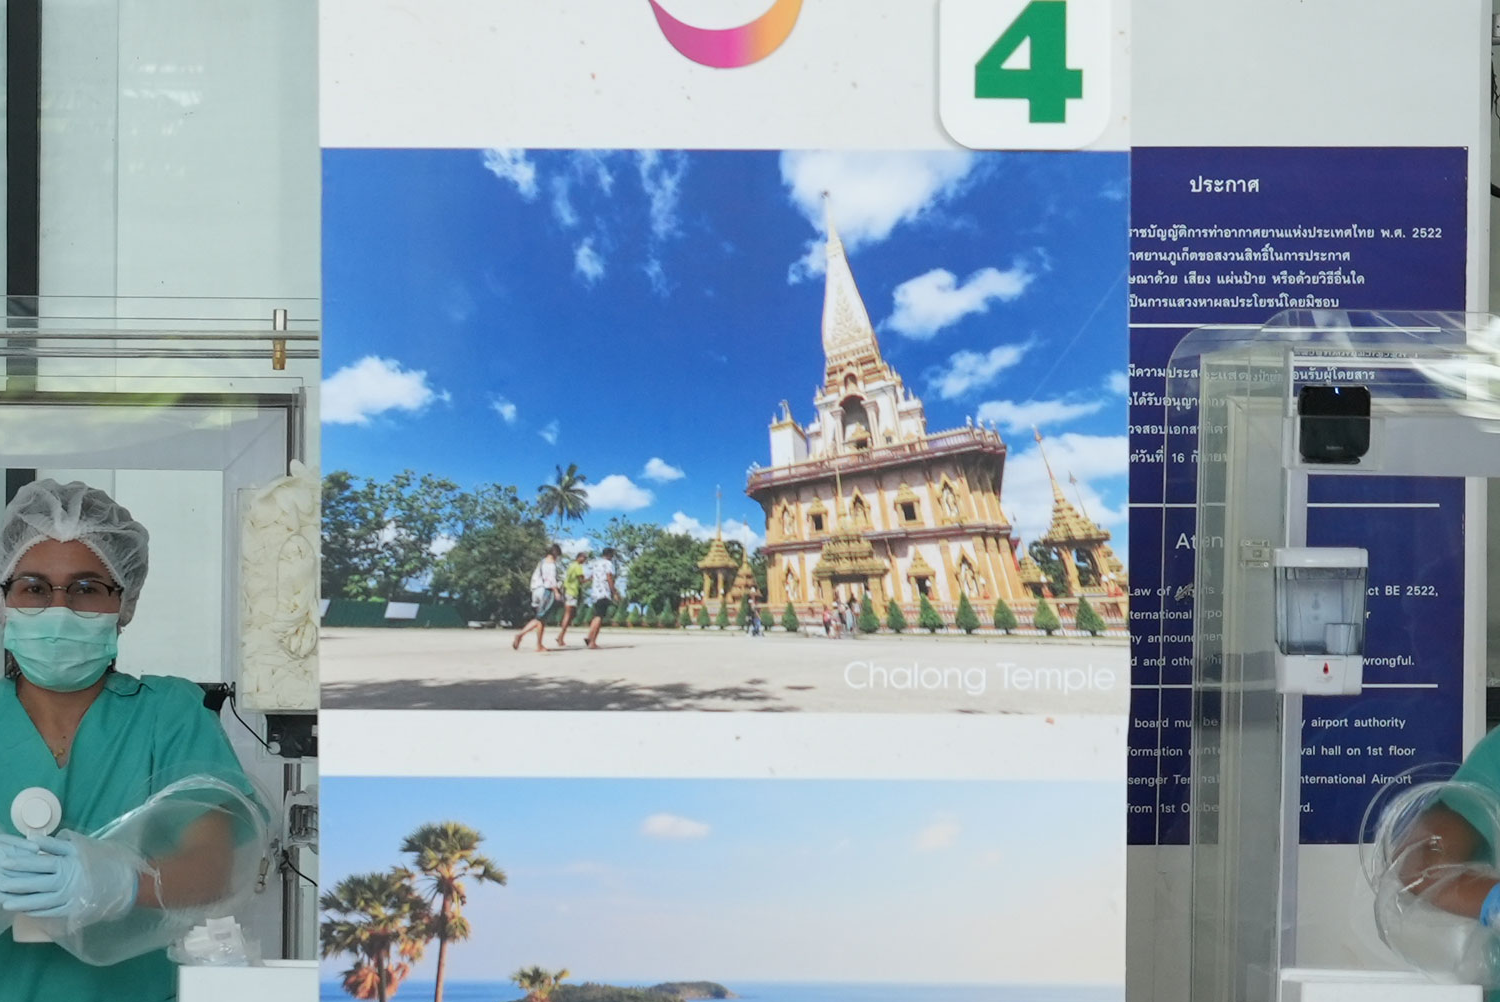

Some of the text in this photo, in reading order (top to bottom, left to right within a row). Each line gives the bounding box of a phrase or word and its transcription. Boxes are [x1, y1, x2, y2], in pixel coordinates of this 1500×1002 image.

[974, 0, 1083, 123] 4
[1189, 175, 1260, 192] ประกาศ
[1380, 228, 1406, 238] พ.ศ.
[1412, 227, 1443, 239] 2522
[1183, 270, 1211, 285] เสียง
[1217, 270, 1266, 285] แผ่นป้าย
[1272, 267, 1366, 285] หรือด้วยวิธีอื่นใด
[1129, 445, 1165, 463] ต่วันที่
[1171, 453, 1185, 463] 16
[1156, 586, 1172, 596] of
[1364, 586, 1380, 596] ct
[1385, 586, 1400, 596] BE
[1406, 586, 1439, 597] 2522,
[1129, 609, 1192, 620] ternational
[1130, 634, 1143, 645] ny
[1143, 656, 1166, 667] and
[843, 660, 1116, 695] Chalong Temple
[1134, 718, 1169, 729] board
[1311, 717, 1349, 729] airport
[1354, 717, 1406, 729] authority
[1321, 746, 1341, 756] hall
[1346, 748, 1361, 756] on
[1366, 746, 1383, 756] 1st
[1388, 746, 1416, 756] floor
[1127, 777, 1169, 787] senger
[1300, 774, 1366, 785] nternational
[1371, 774, 1412, 785] Airport
[1160, 803, 1176, 813] 1st
